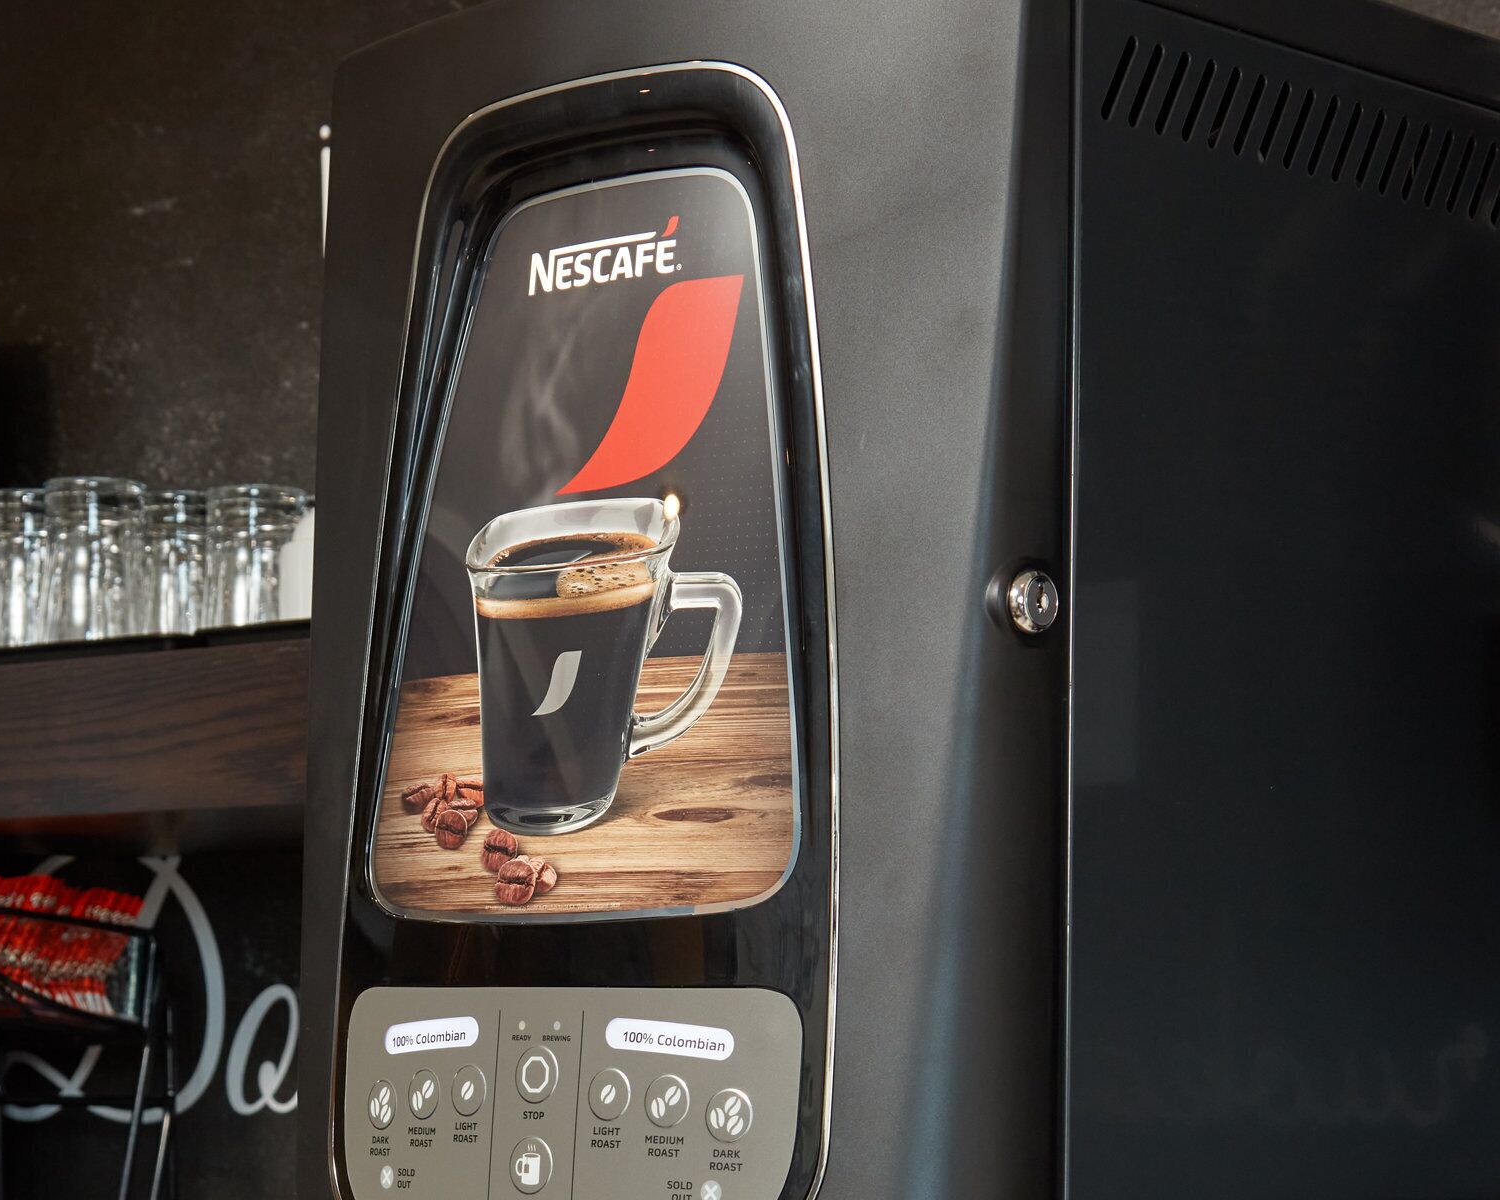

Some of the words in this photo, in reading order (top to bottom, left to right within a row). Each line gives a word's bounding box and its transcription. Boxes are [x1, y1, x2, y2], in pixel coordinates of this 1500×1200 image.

[528, 216, 680, 296] NESCAFÉ
[392, 1035, 414, 1048] 100%
[415, 1030, 467, 1045] Colombian
[511, 1034, 532, 1042] READY
[542, 1034, 571, 1042] BREWING
[622, 1031, 654, 1045] 100%
[657, 1034, 726, 1052] Colombian
[522, 1110, 545, 1120] STOP
[407, 1126, 436, 1136] MEDIUM
[454, 1121, 478, 1131] LIGHT
[592, 1126, 621, 1136] LIGHT
[371, 1135, 389, 1145] DARK
[409, 1138, 433, 1148] ROAST
[452, 1133, 478, 1144] ROAST
[644, 1135, 684, 1145] MEDIUM
[590, 1139, 622, 1149] ROAST
[369, 1147, 391, 1157] ROAST
[647, 1147, 681, 1158] ROAST
[712, 1148, 741, 1159] DARK
[709, 1161, 744, 1172] ROAST
[397, 1167, 416, 1177] SOLD
[397, 1180, 412, 1189] OUT
[666, 1180, 693, 1191] SOLD
